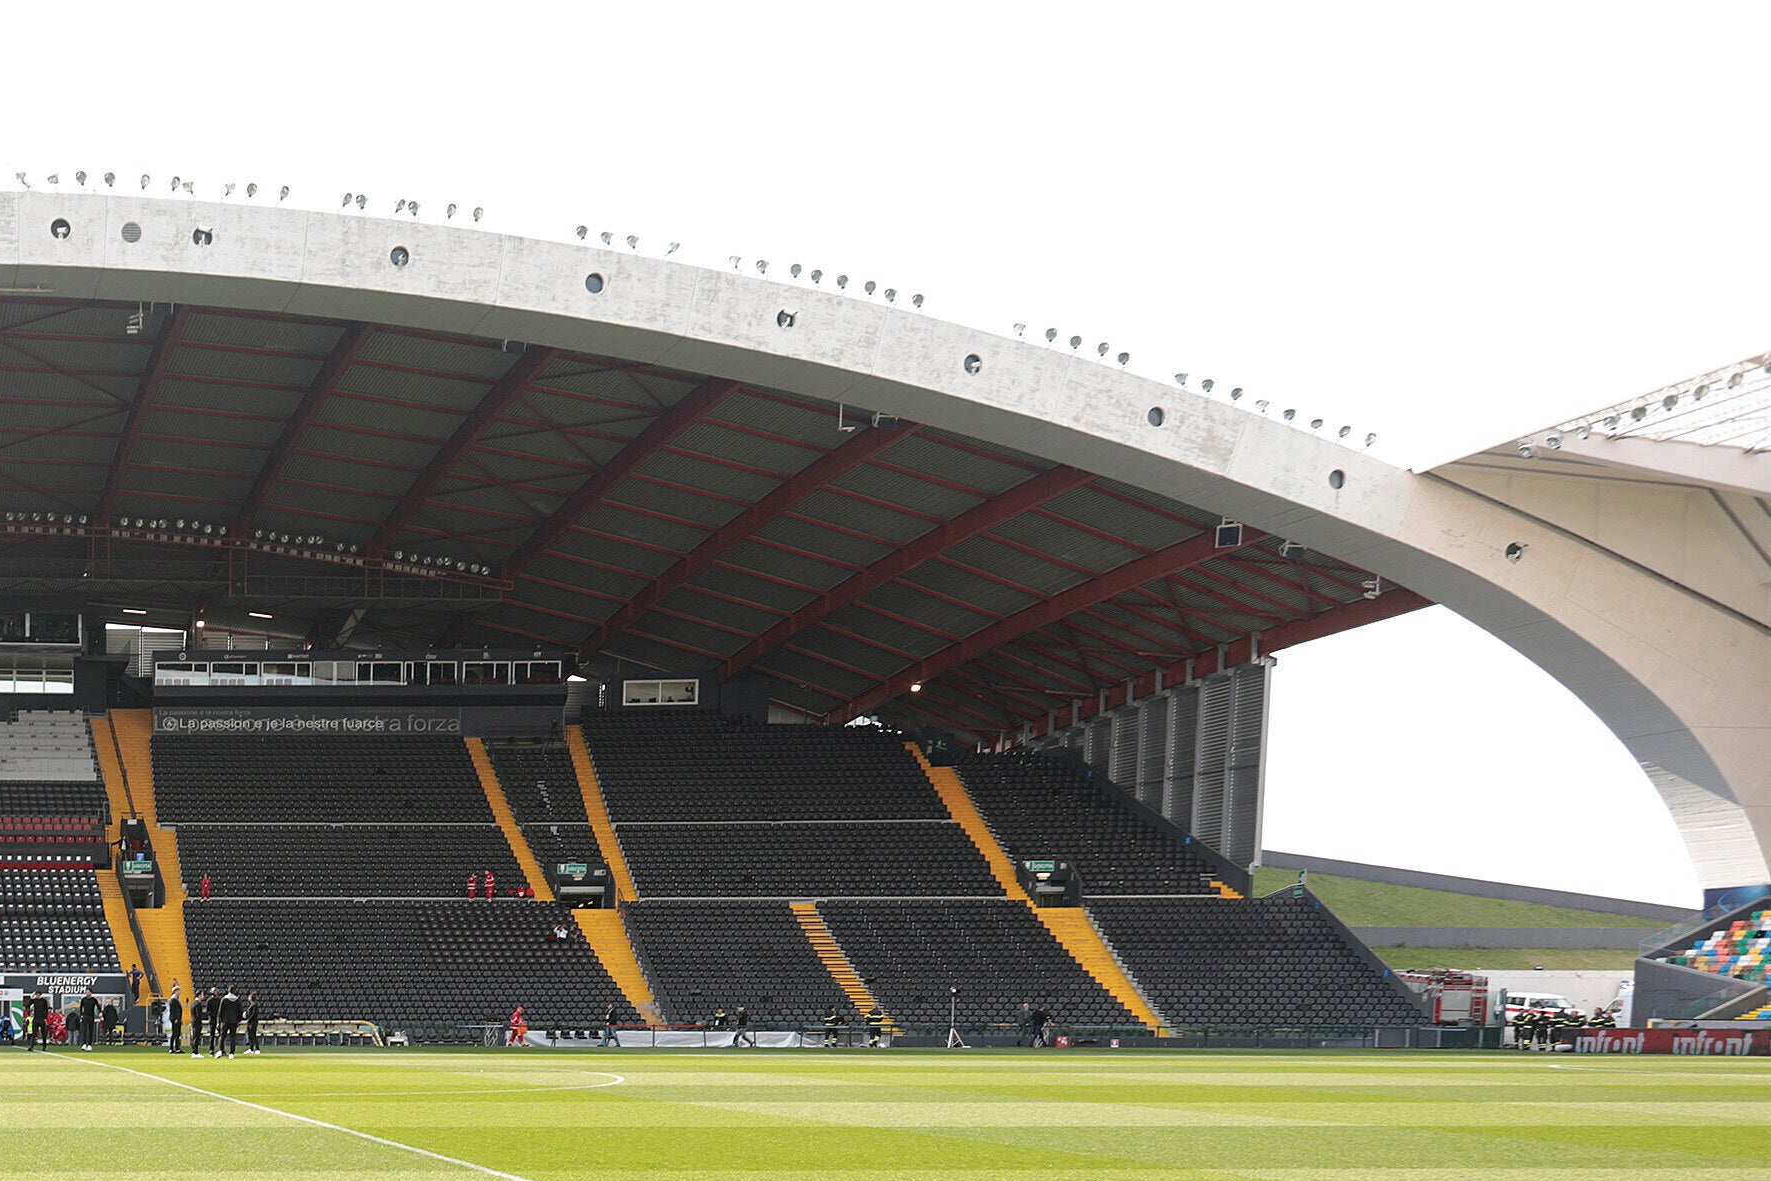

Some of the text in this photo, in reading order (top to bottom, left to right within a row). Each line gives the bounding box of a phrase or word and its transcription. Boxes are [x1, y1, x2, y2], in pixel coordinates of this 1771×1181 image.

[180, 718, 195, 728] La
[200, 717, 250, 730] passion
[283, 718, 293, 728] la
[406, 714, 460, 731] forza
[37, 976, 97, 985] BLUENERGY
[48, 986, 87, 994] STADIUM
